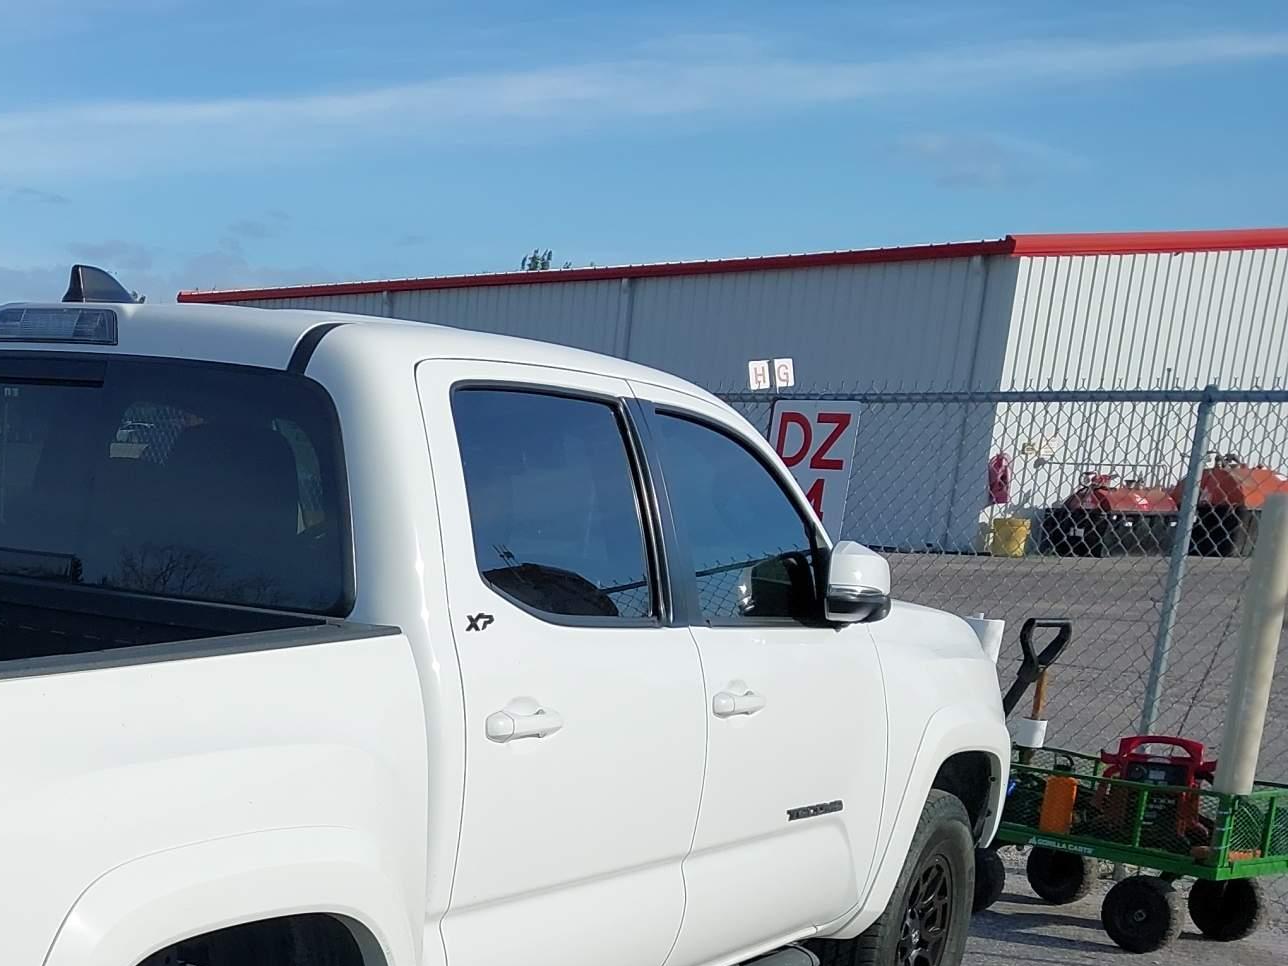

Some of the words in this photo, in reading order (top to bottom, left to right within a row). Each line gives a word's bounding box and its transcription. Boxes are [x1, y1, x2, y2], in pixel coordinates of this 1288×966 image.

[753, 367, 766, 384] H
[777, 364, 789, 383] G
[776, 412, 852, 470] DZ
[465, 612, 495, 632] XP
